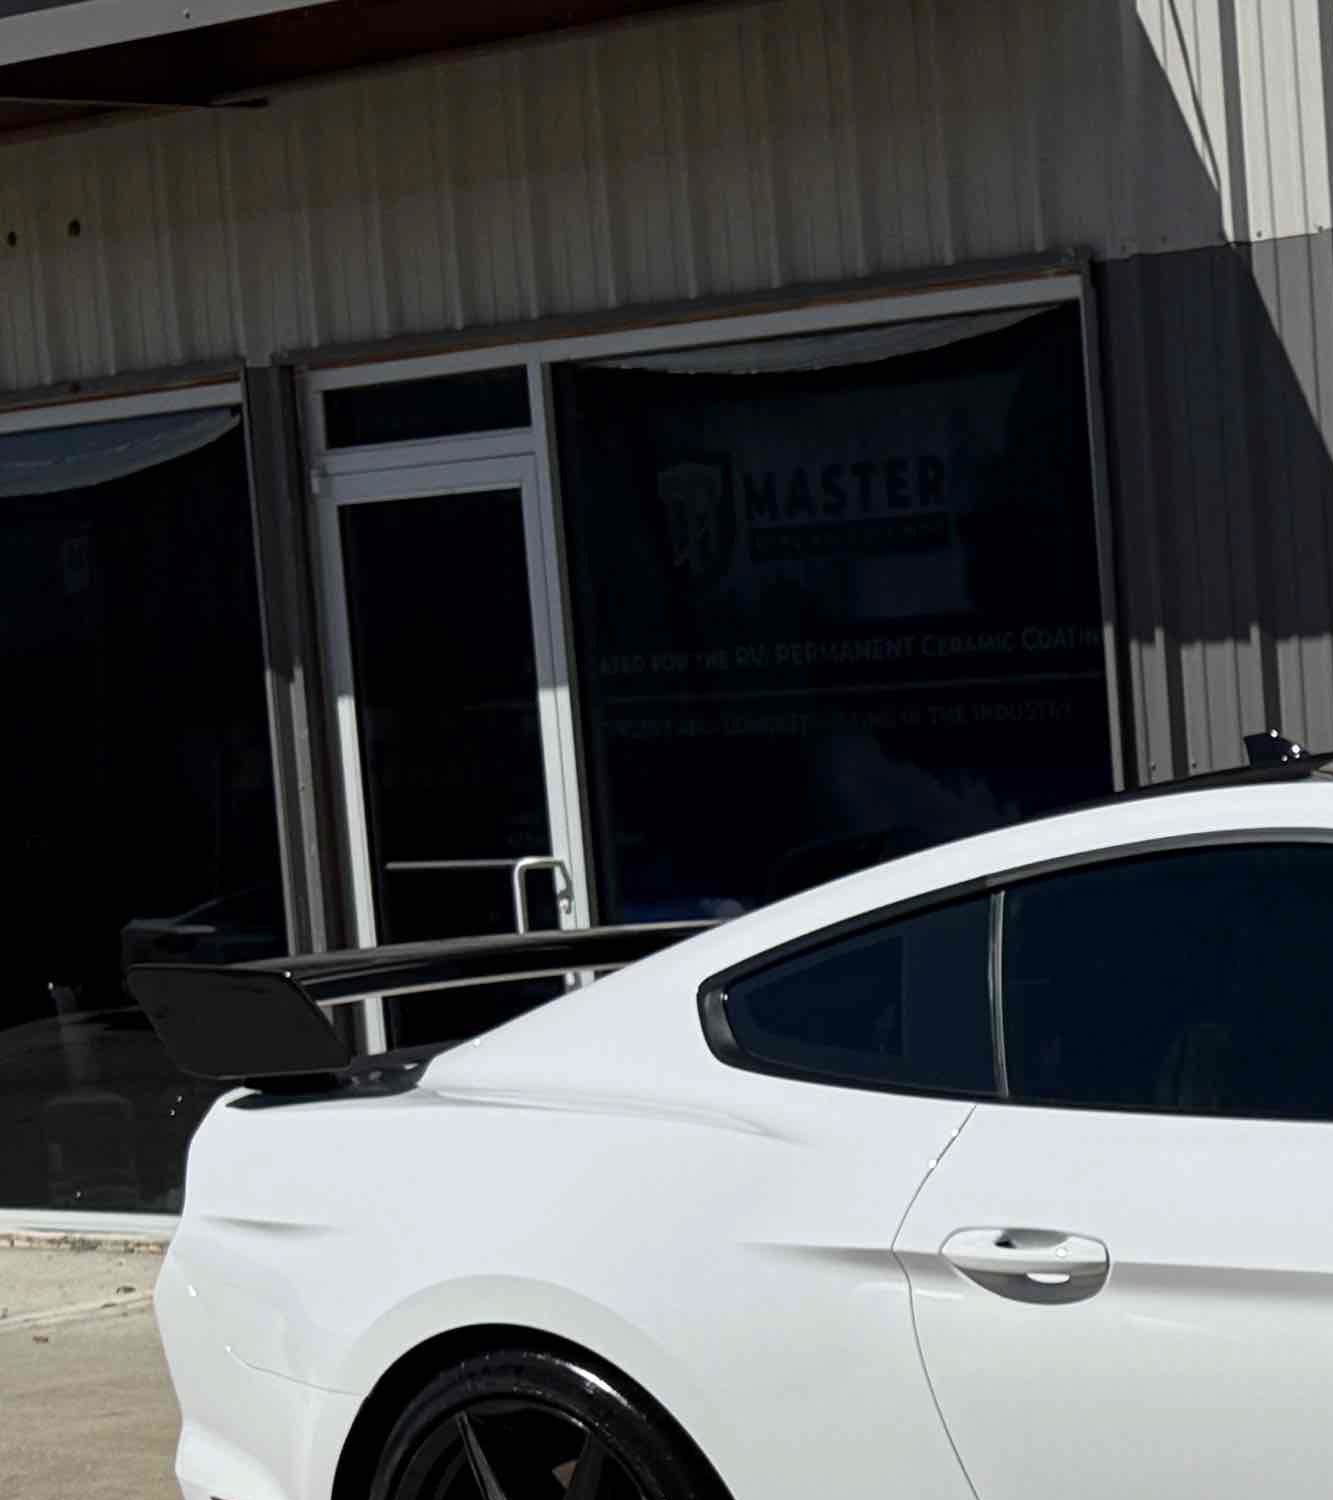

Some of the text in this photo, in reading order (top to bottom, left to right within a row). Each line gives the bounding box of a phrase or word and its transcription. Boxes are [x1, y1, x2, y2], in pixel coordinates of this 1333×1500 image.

[743, 455, 945, 522] MASTER
[921, 631, 1017, 657] CERAMIC
[1021, 624, 1101, 652] COATIN
